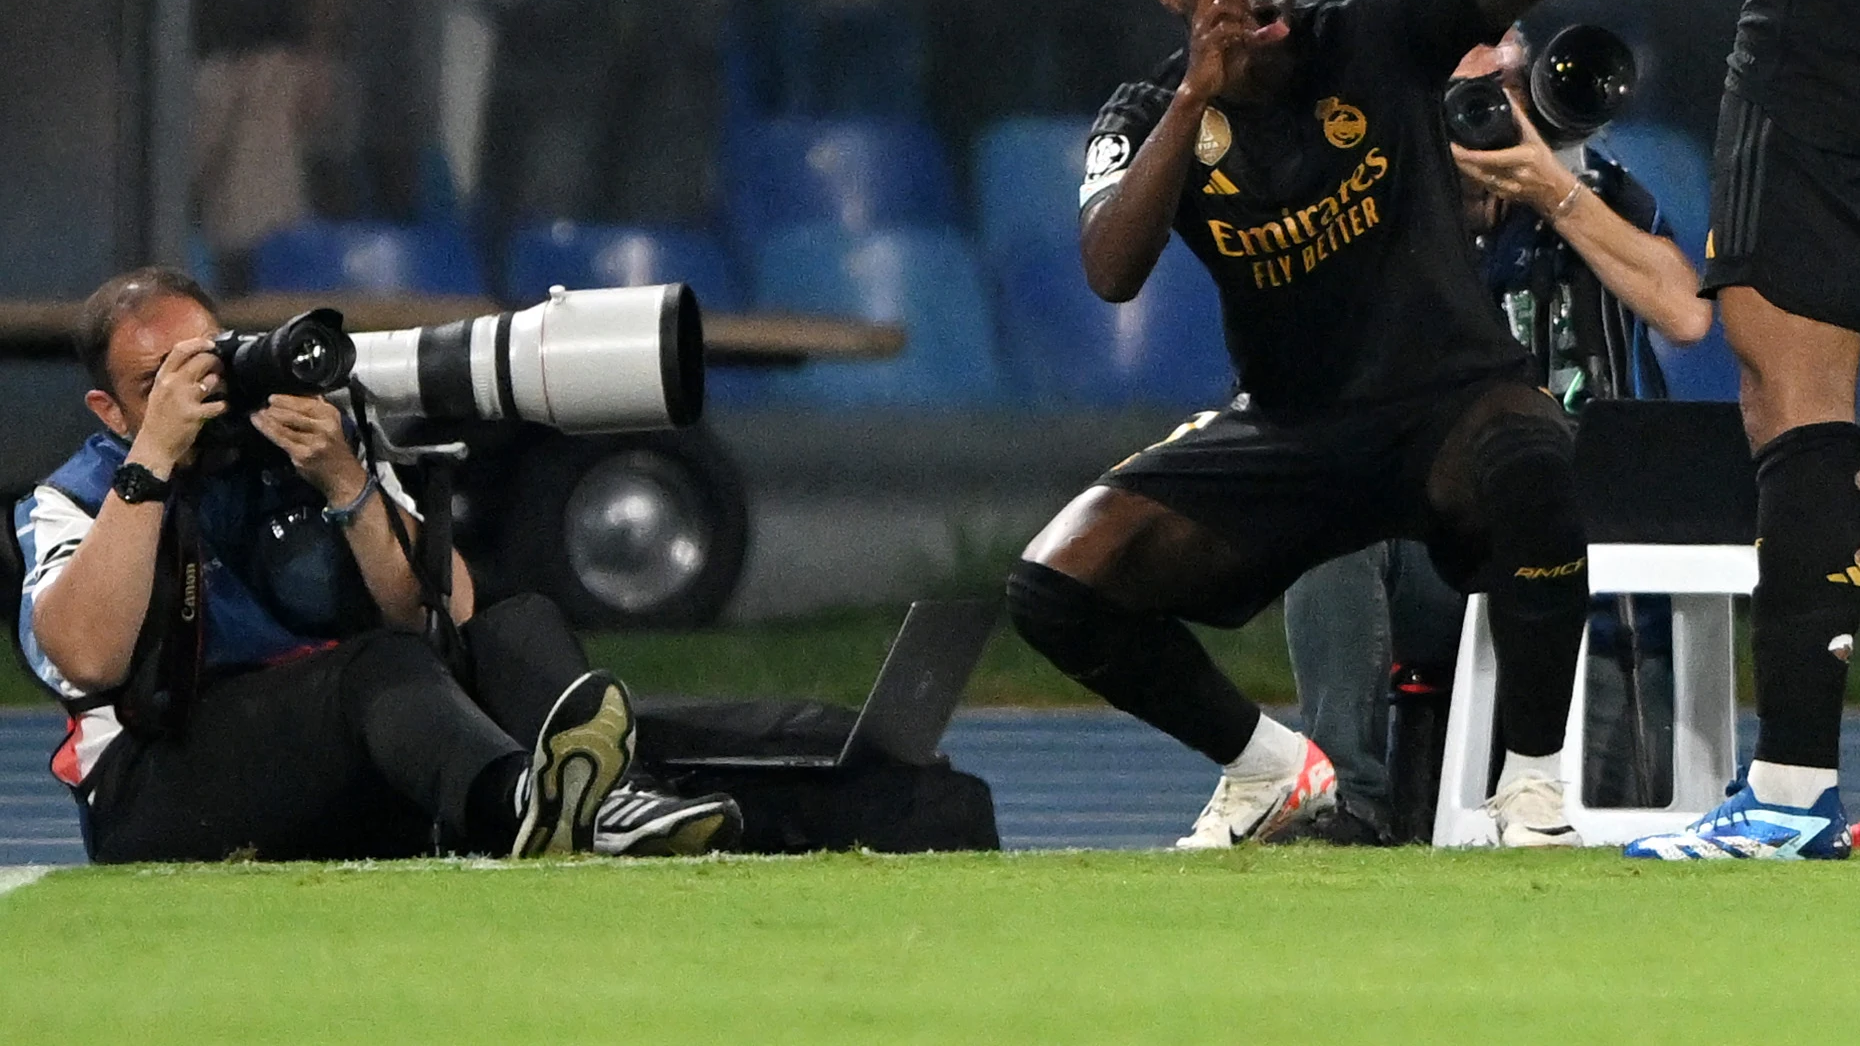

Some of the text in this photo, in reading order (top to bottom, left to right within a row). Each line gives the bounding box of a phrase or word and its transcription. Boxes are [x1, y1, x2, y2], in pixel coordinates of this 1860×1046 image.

[1208, 147, 1388, 257] Emirates
[1252, 196, 1380, 289] FLY BETTER
[181, 563, 196, 621] Canon
